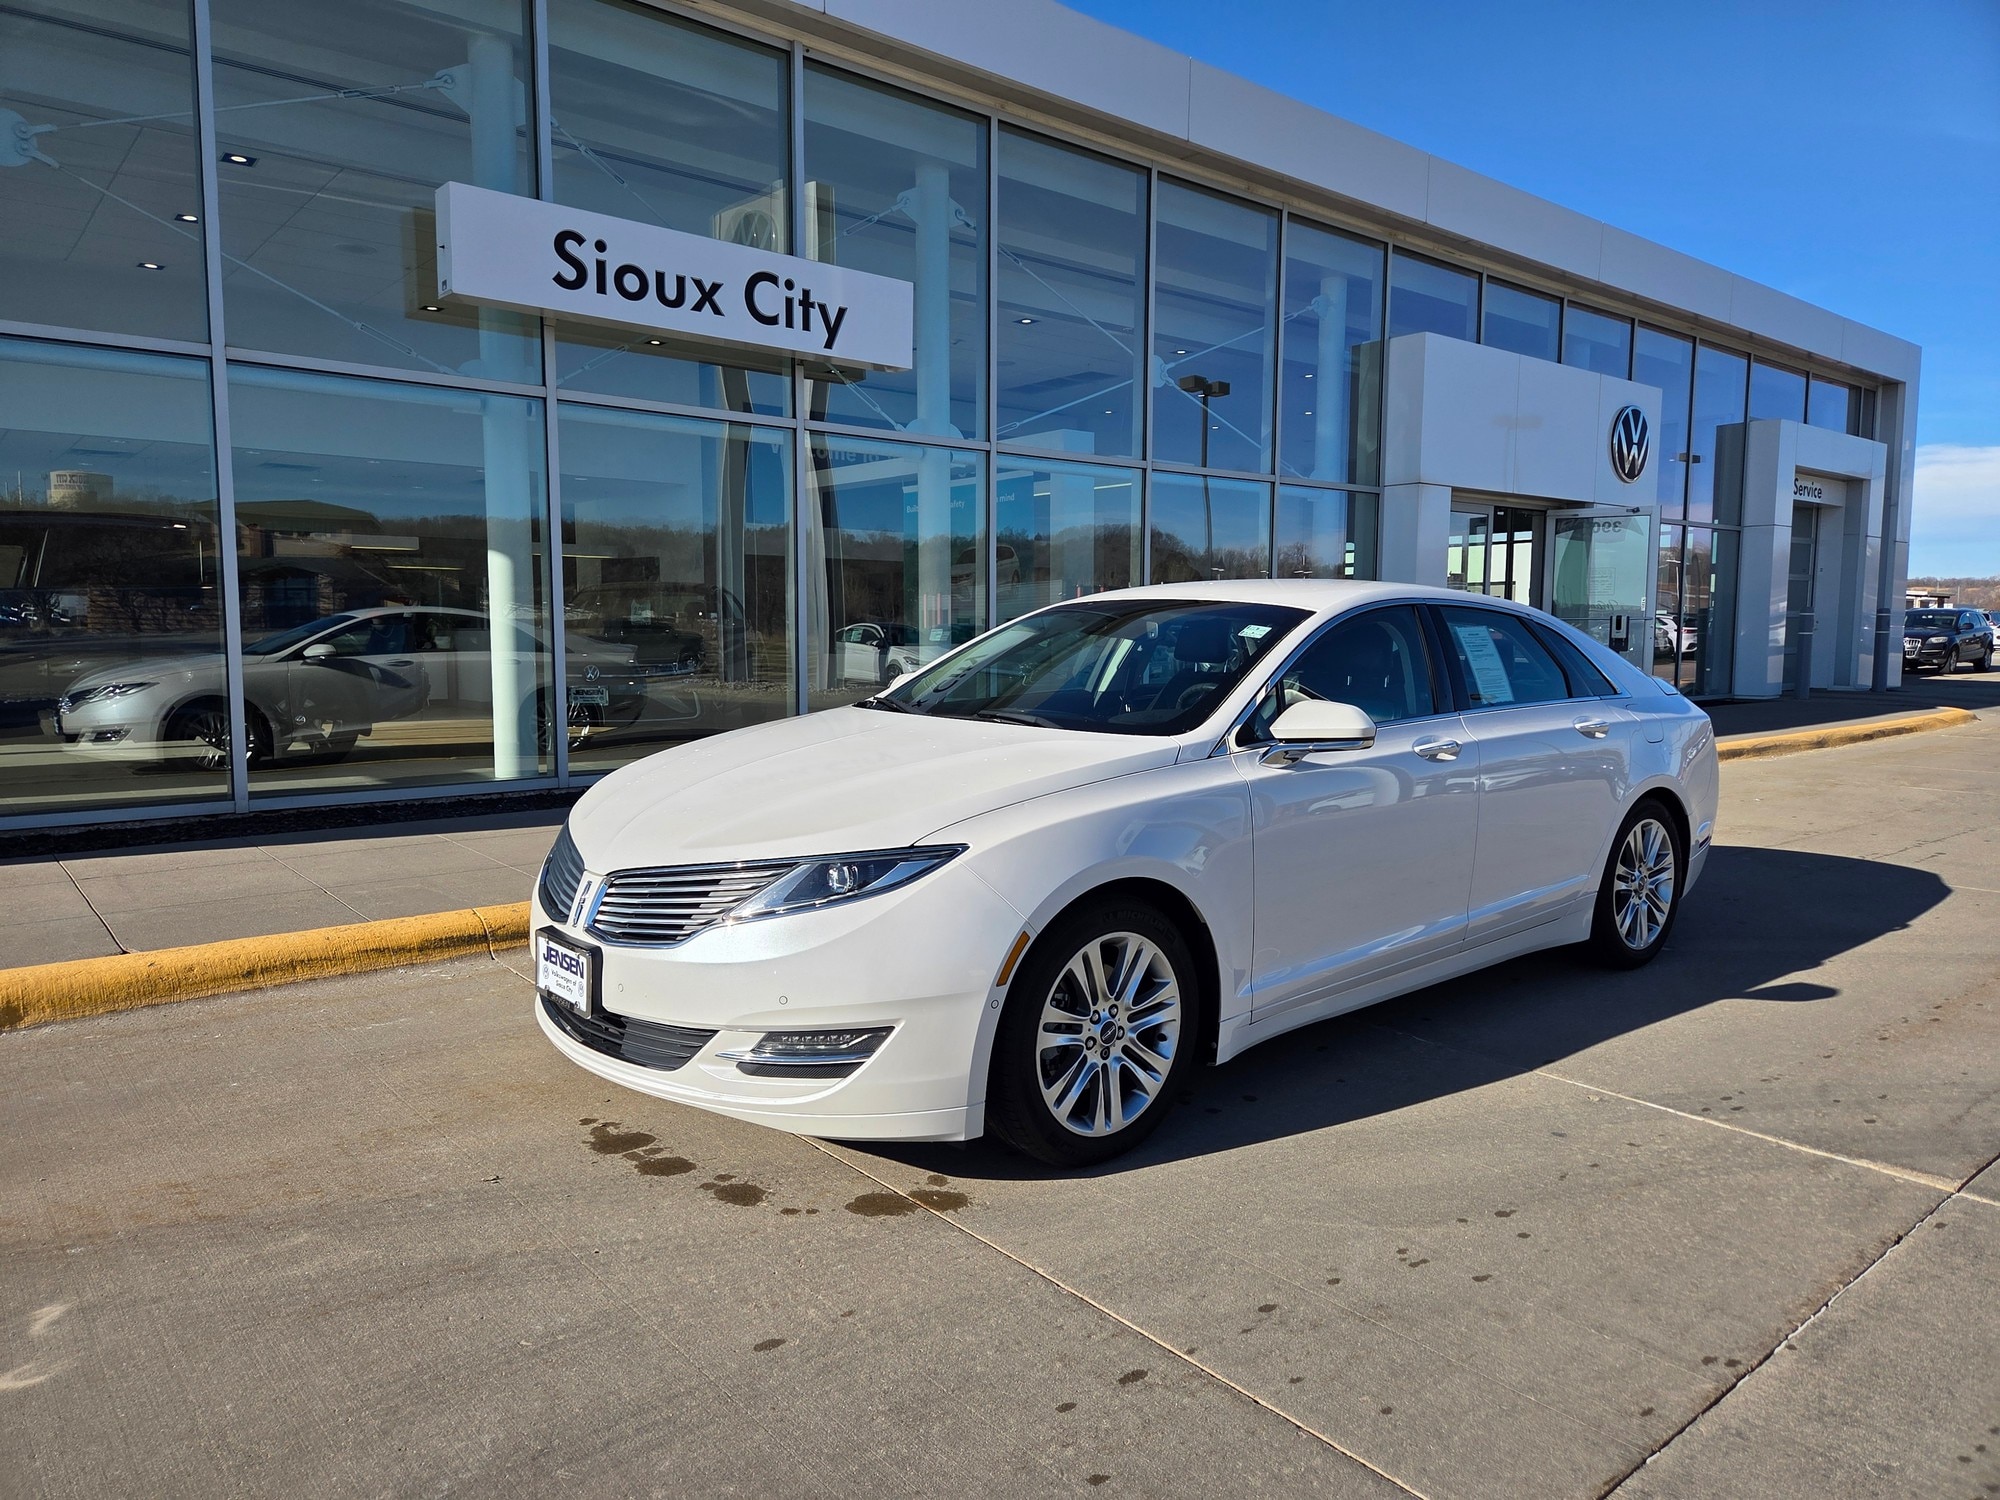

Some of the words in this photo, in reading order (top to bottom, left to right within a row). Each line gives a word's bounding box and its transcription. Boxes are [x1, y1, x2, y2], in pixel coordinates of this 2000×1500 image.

[552, 229, 725, 318] Sioux
[743, 270, 849, 351] City
[999, 492, 1015, 502] mind
[1793, 477, 1823, 499] Service
[543, 945, 584, 979] JENSEN
